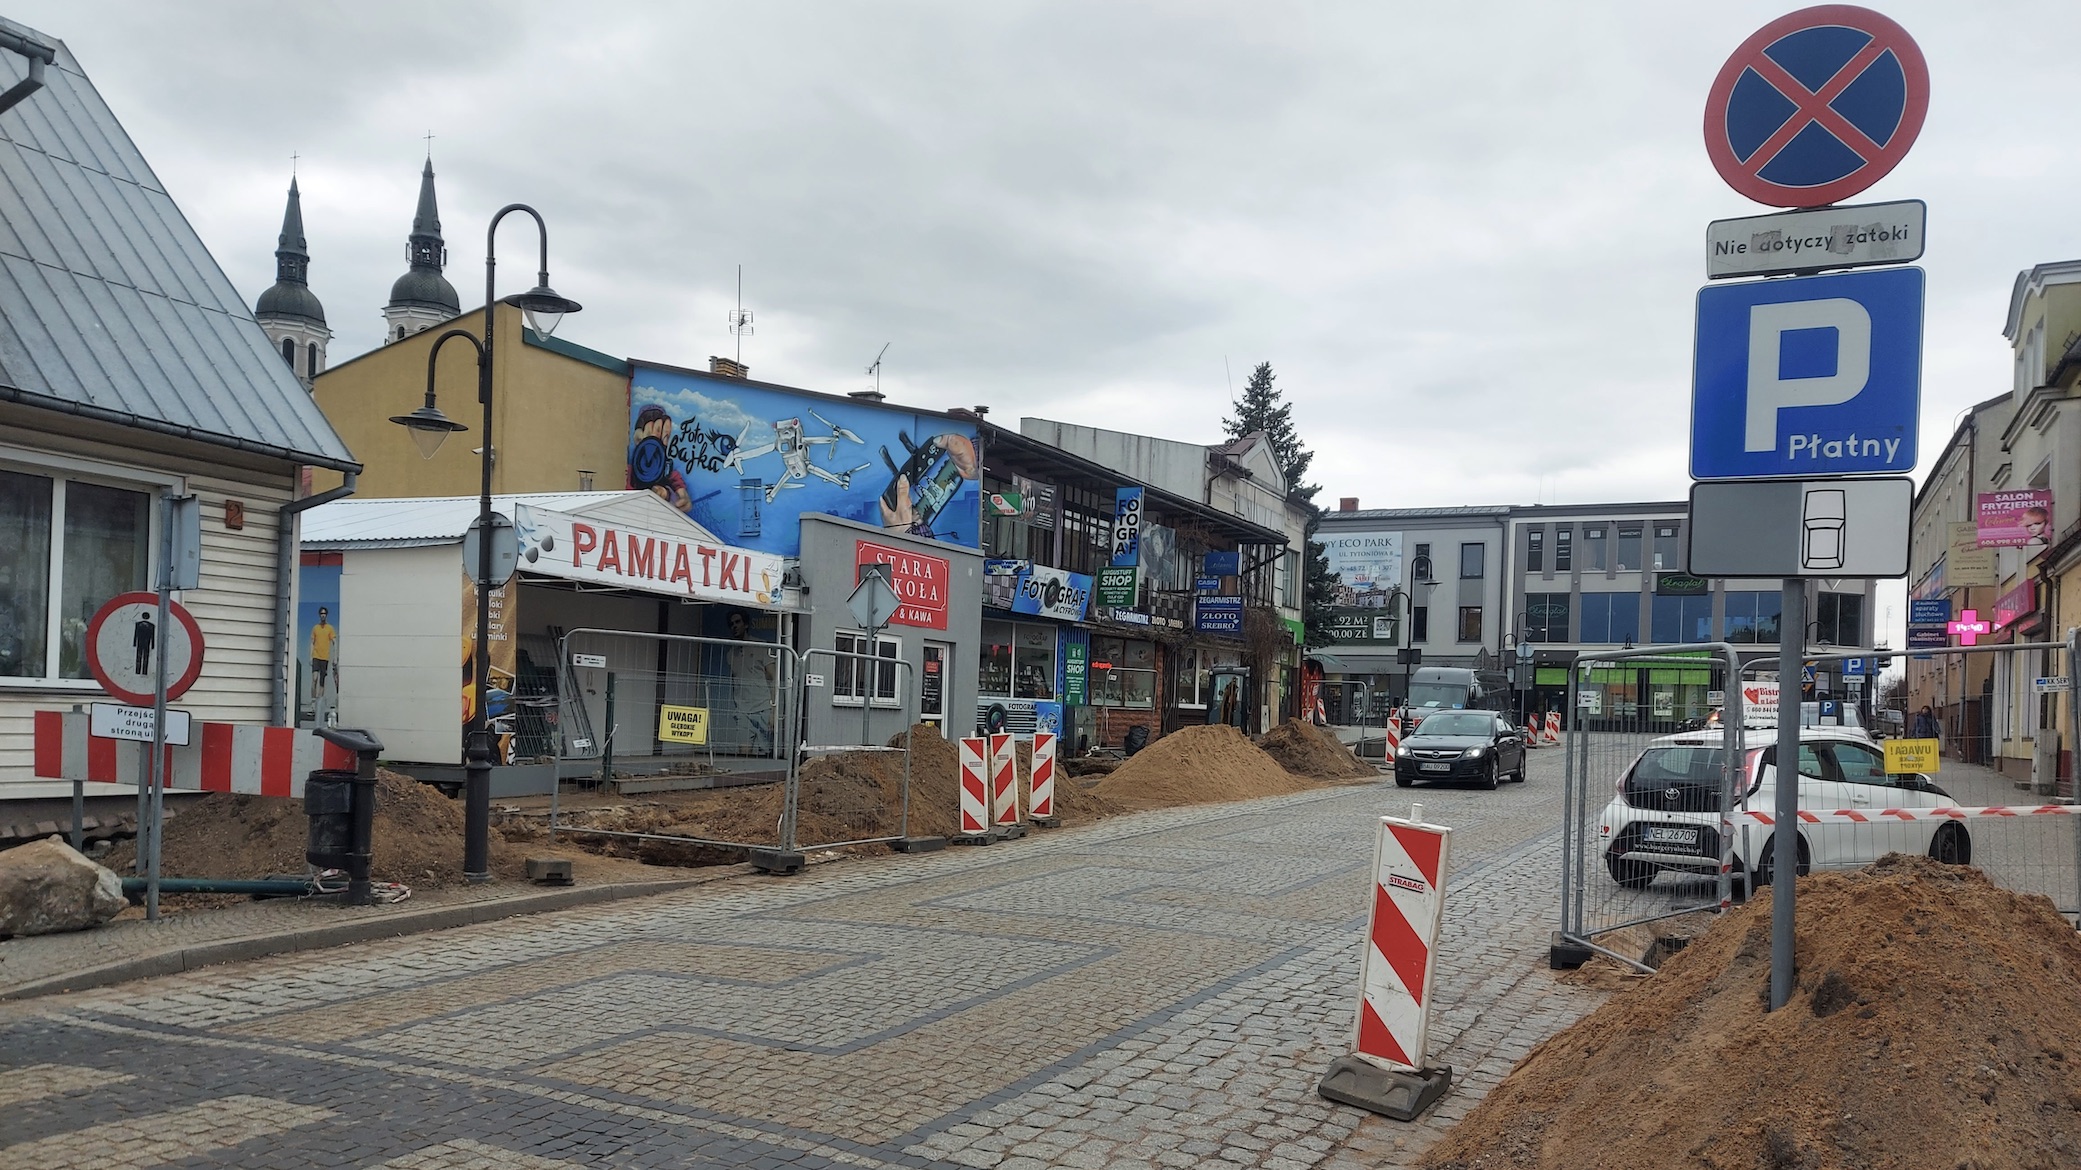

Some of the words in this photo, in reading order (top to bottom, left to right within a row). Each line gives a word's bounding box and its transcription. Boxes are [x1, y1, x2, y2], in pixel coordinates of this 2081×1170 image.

[1715, 239, 1748, 257] Nie
[1759, 229, 1835, 256] dotyczy
[1846, 223, 1909, 246] zatoki
[1744, 297, 1872, 454] P
[680, 415, 704, 444] Foto
[668, 434, 721, 475] Bajka
[1788, 433, 1902, 464] Płatny
[1995, 492, 2034, 502] SALON
[1981, 500, 2048, 511] FRYZJERSKI
[1339, 538, 1361, 548] ECO
[1365, 537, 1392, 547] PARK
[572, 522, 751, 594] PAMIĄTKI
[876, 552, 933, 579] STARA
[1101, 575, 1132, 586] SHOP
[892, 577, 939, 602] KOŁA
[1198, 596, 1241, 604] ZEGARMISTRZ
[908, 609, 932, 623] KAWA
[1115, 610, 1149, 625] ZEGARMISTRZ
[1201, 612, 1236, 620] ZŁOTO
[1339, 616, 1351, 625] 92
[1201, 622, 1235, 630] SREBRO
[1955, 623, 1984, 632] 14:40
[1066, 664, 1084, 674] SHOP
[1848, 658, 1861, 672] P
[1760, 687, 1780, 696] Bistr
[1008, 703, 1037, 711] FOTOGRAF
[1824, 701, 1833, 713] P
[667, 711, 702, 723] UWAGA!
[111, 727, 143, 738] stroną
[671, 730, 693, 738] WYKOPY
[1650, 828, 1666, 840] NEL
[1668, 830, 1697, 841] 26709
[1389, 876, 1424, 891] STRABAG
